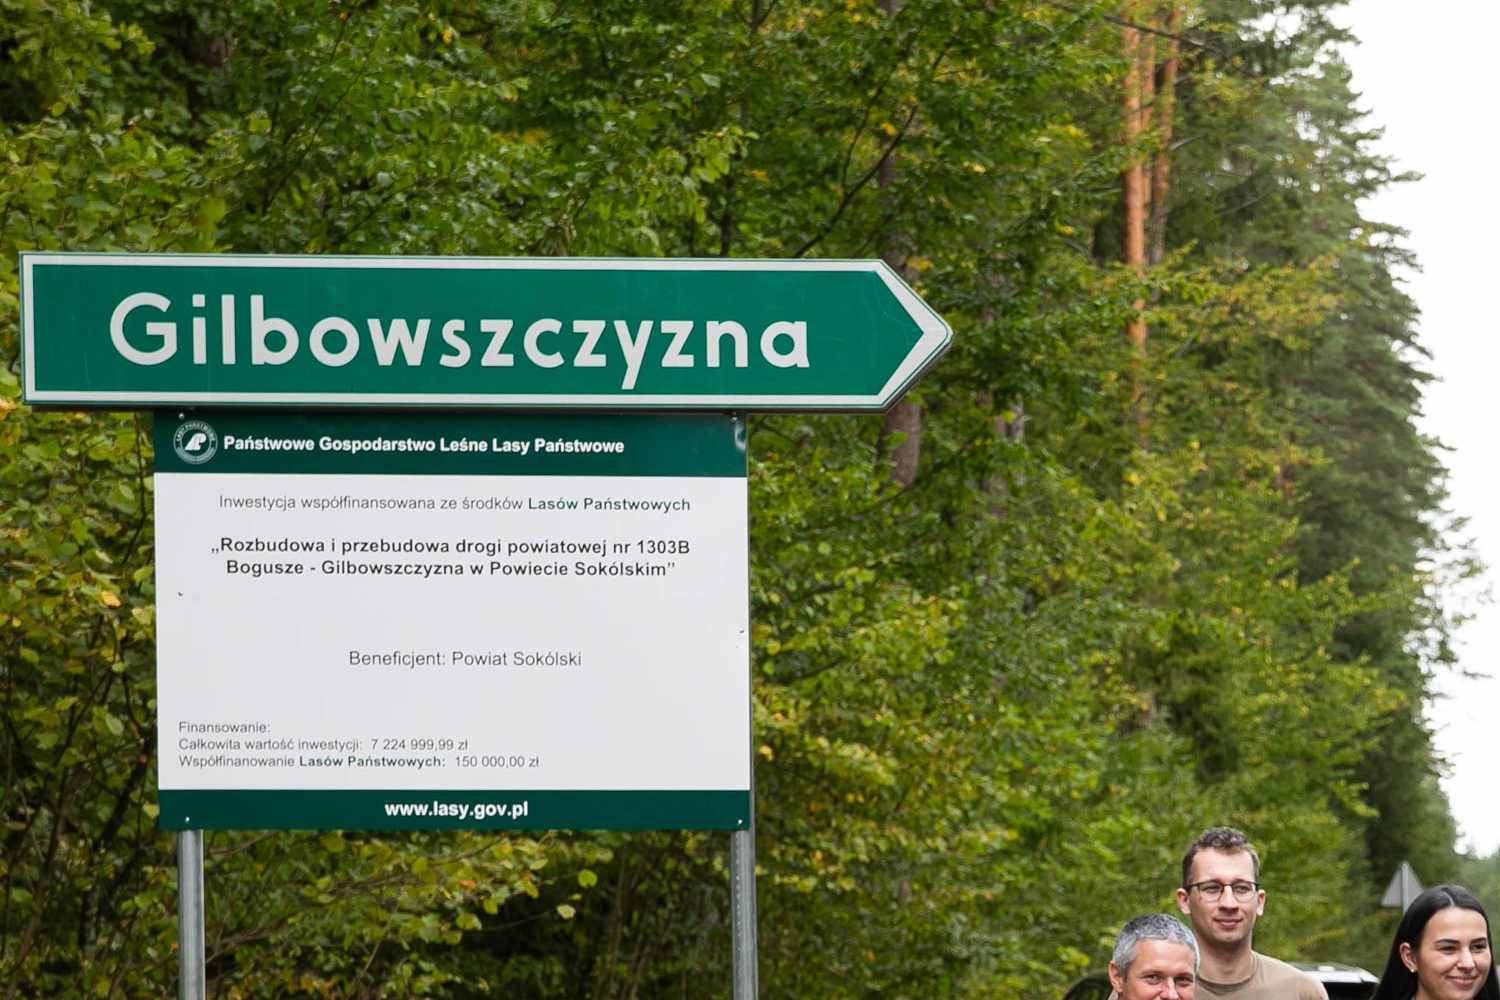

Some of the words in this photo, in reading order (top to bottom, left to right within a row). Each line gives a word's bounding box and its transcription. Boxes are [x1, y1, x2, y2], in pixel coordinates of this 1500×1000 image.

[109, 291, 811, 390] Gilbowszczyzna
[223, 435, 315, 451] Państwowe
[318, 435, 436, 455] Gospodarstwo
[439, 437, 489, 453] Leśne
[492, 437, 531, 456] Lasy
[534, 437, 625, 454] Państwowe
[219, 494, 296, 512] Inwestycja
[300, 495, 436, 512] współfinansowana
[440, 499, 458, 510] ze
[462, 496, 524, 510] środków
[528, 497, 579, 510] Lasów
[583, 497, 691, 514] Państwowych
[331, 537, 335, 552] i
[341, 538, 450, 556] przebudowa
[455, 538, 502, 557] drogi
[507, 539, 607, 558] powiatowej
[613, 543, 631, 554] nr
[637, 539, 690, 555] 1303B
[226, 559, 304, 578] Bogusze
[321, 559, 464, 579] Gilbowszczyzna
[469, 564, 484, 575] w
[490, 561, 569, 576] Powiecie
[349, 650, 446, 670] Beneficjent:
[452, 651, 508, 666] Powiat
[513, 651, 582, 666] Sokólski
[178, 721, 270, 734] Finansowanie:
[178, 738, 241, 751] Całkowita
[244, 738, 295, 750] wartość
[298, 739, 362, 753] inwestycji:
[371, 738, 379, 750] 7
[382, 738, 406, 751] 224
[410, 738, 454, 752] 999,99
[457, 739, 468, 751] zł
[178, 755, 295, 769] Współfinanowanie
[299, 755, 344, 767] Lasów
[347, 755, 446, 770] Państwowych:
[455, 755, 478, 767] 150
[481, 755, 525, 768] 000,00
[529, 756, 540, 768] zł
[384, 800, 529, 821] www.lasy.gov.pl
